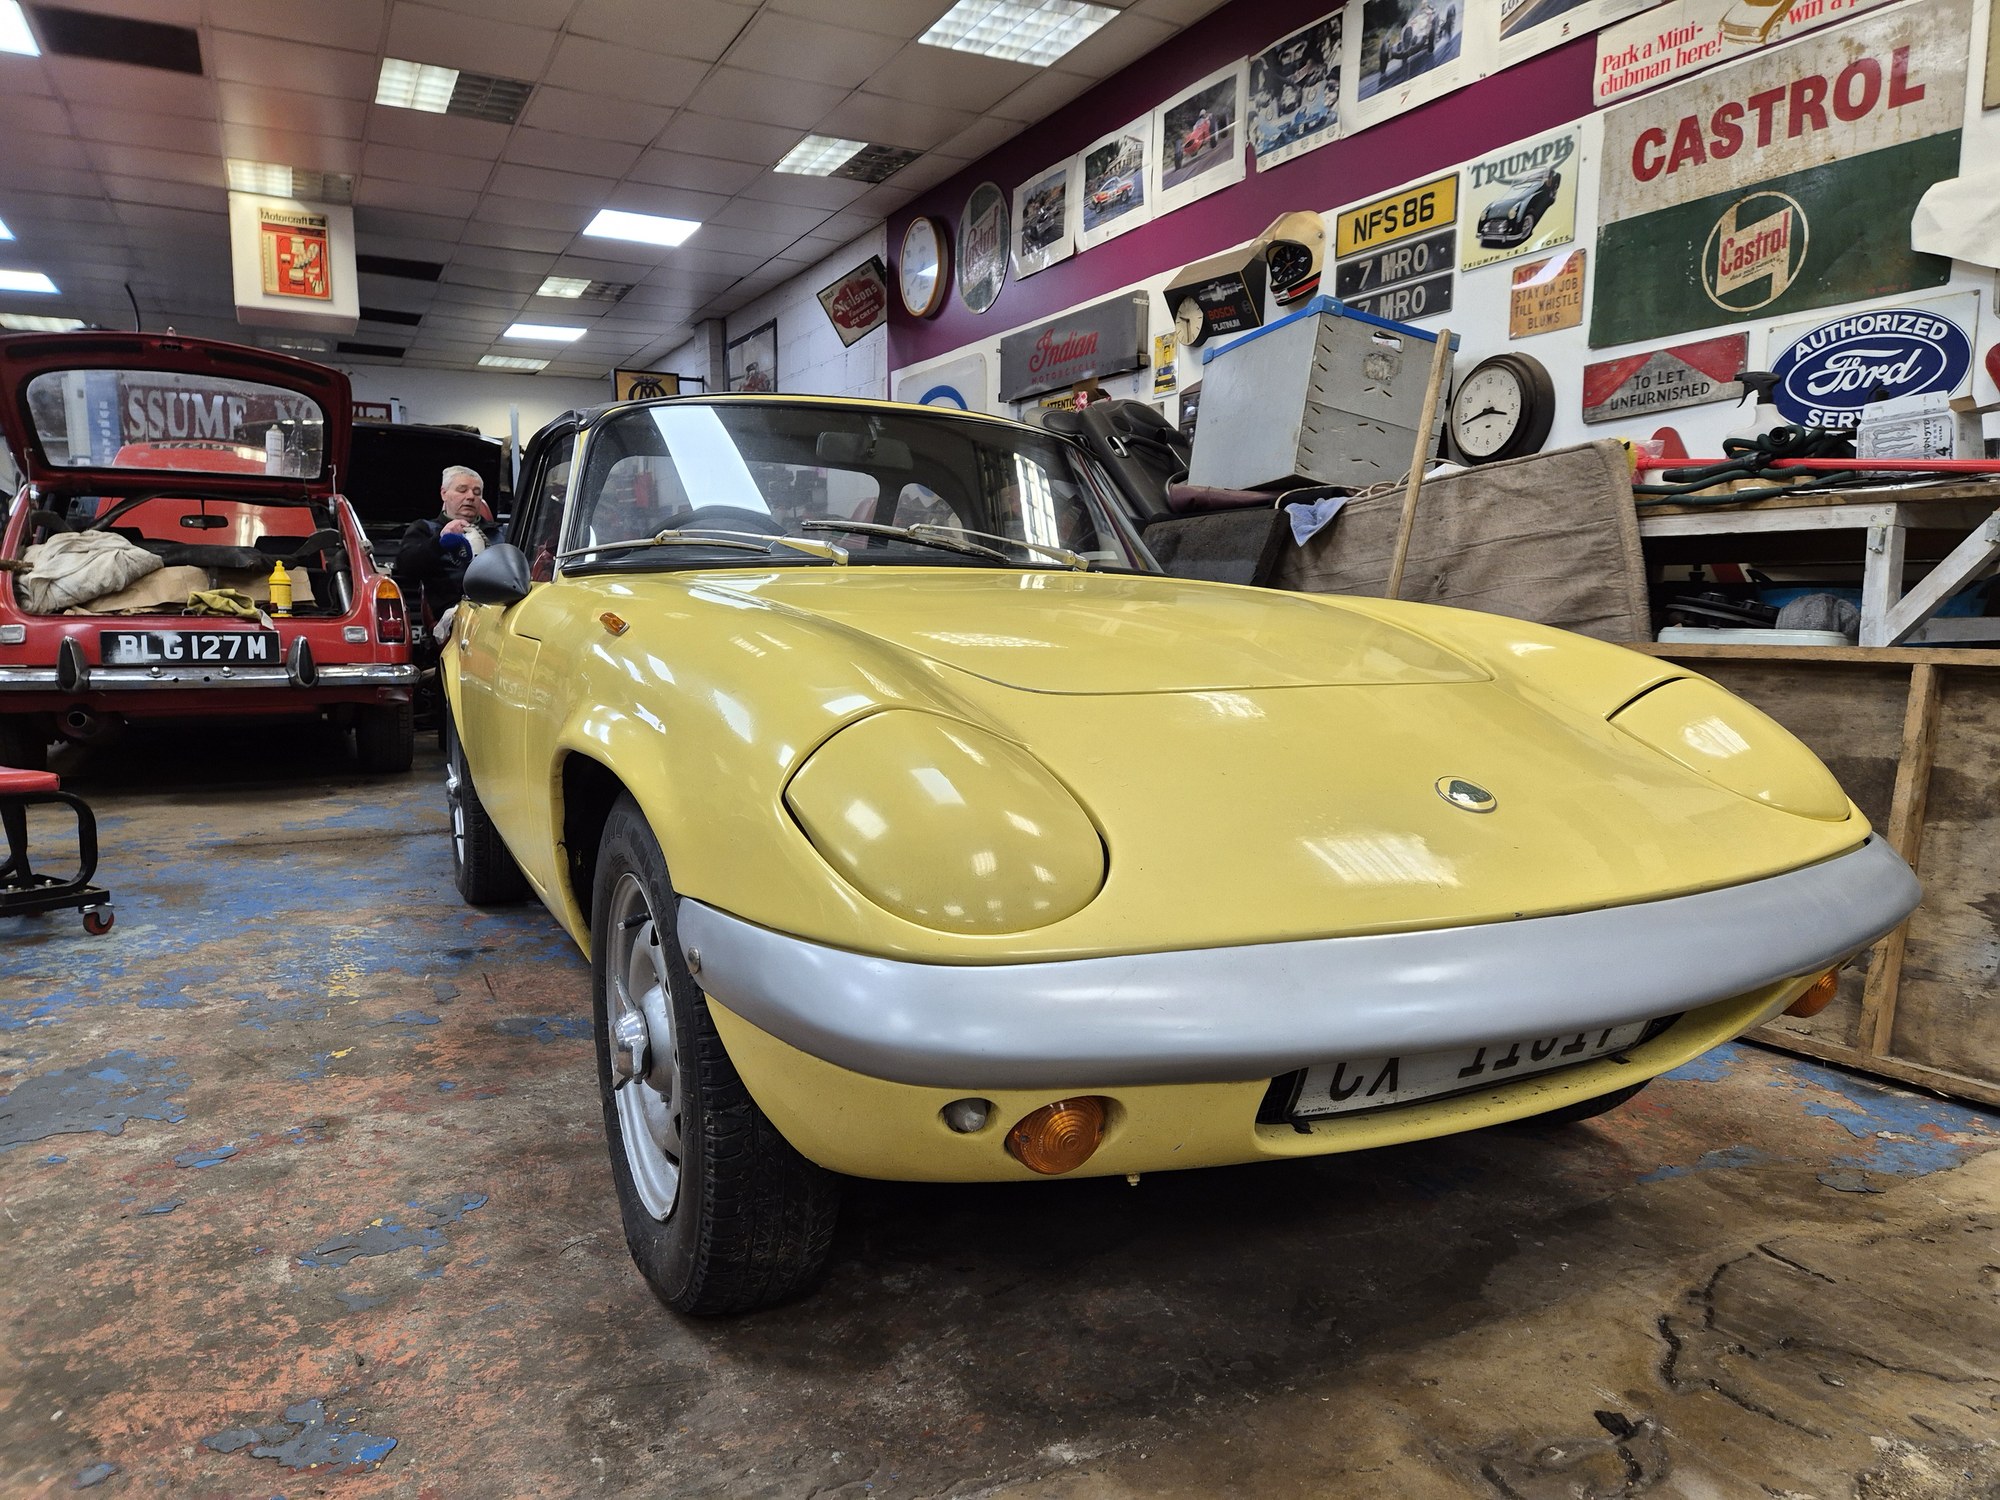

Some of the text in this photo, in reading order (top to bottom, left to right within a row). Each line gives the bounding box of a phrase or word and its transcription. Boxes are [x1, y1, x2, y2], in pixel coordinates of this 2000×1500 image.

[1600, 31, 1723, 97] clubman here!
[1602, 21, 1704, 75] Park a Mini-
[1632, 45, 1926, 182] CASTROL
[1471, 134, 1575, 189] TRIUMPH
[260, 208, 308, 225] Motorcraft
[1353, 191, 1436, 245] NFS 86
[1463, 254, 1501, 270] TRIUMPH
[1720, 211, 1790, 277] Castrol
[1358, 243, 1429, 291] 7 MRO
[1379, 285, 1427, 321] MRO
[1515, 292, 1580, 318] TILL WHISTLE
[1516, 277, 1579, 303] STAY ON JOB
[1207, 304, 1237, 320] BOSCH
[1212, 318, 1242, 332] PLATINUM
[1527, 312, 1561, 330] BLOWS
[1028, 327, 1100, 373] Indian
[1794, 314, 1949, 362] AUTHORIZED
[1031, 360, 1098, 385] MOTORCYCLE
[1633, 369, 1686, 391] TO LET
[1806, 348, 1924, 397] Ford
[1046, 397, 1076, 410] ATTENTIO
[1610, 381, 1711, 411] UNFURNISHED
[122, 389, 246, 440] SSUME
